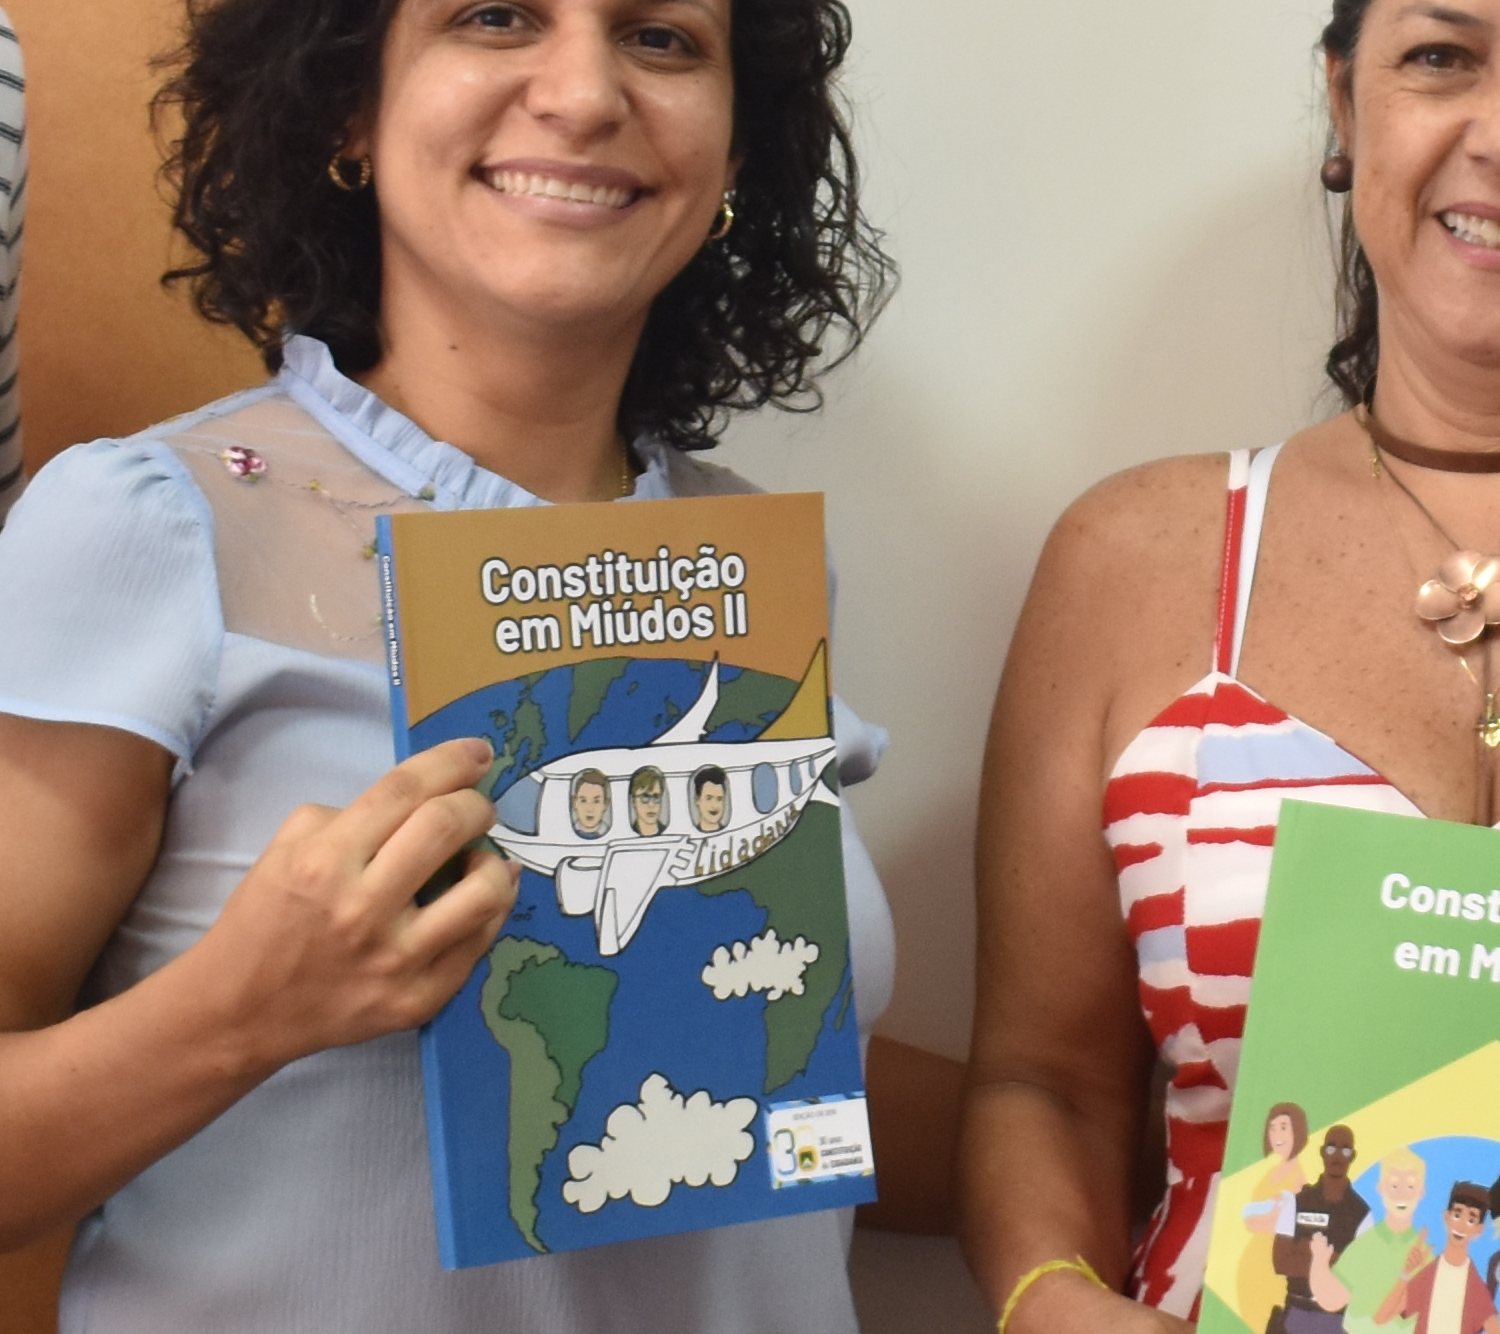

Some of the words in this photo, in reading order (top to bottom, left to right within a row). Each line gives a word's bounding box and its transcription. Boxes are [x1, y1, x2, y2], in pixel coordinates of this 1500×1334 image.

[481, 544, 747, 606] Constituição
[495, 615, 562, 655] em
[569, 592, 713, 650] Miúdos
[722, 591, 749, 638] II
[1393, 939, 1460, 977] em
